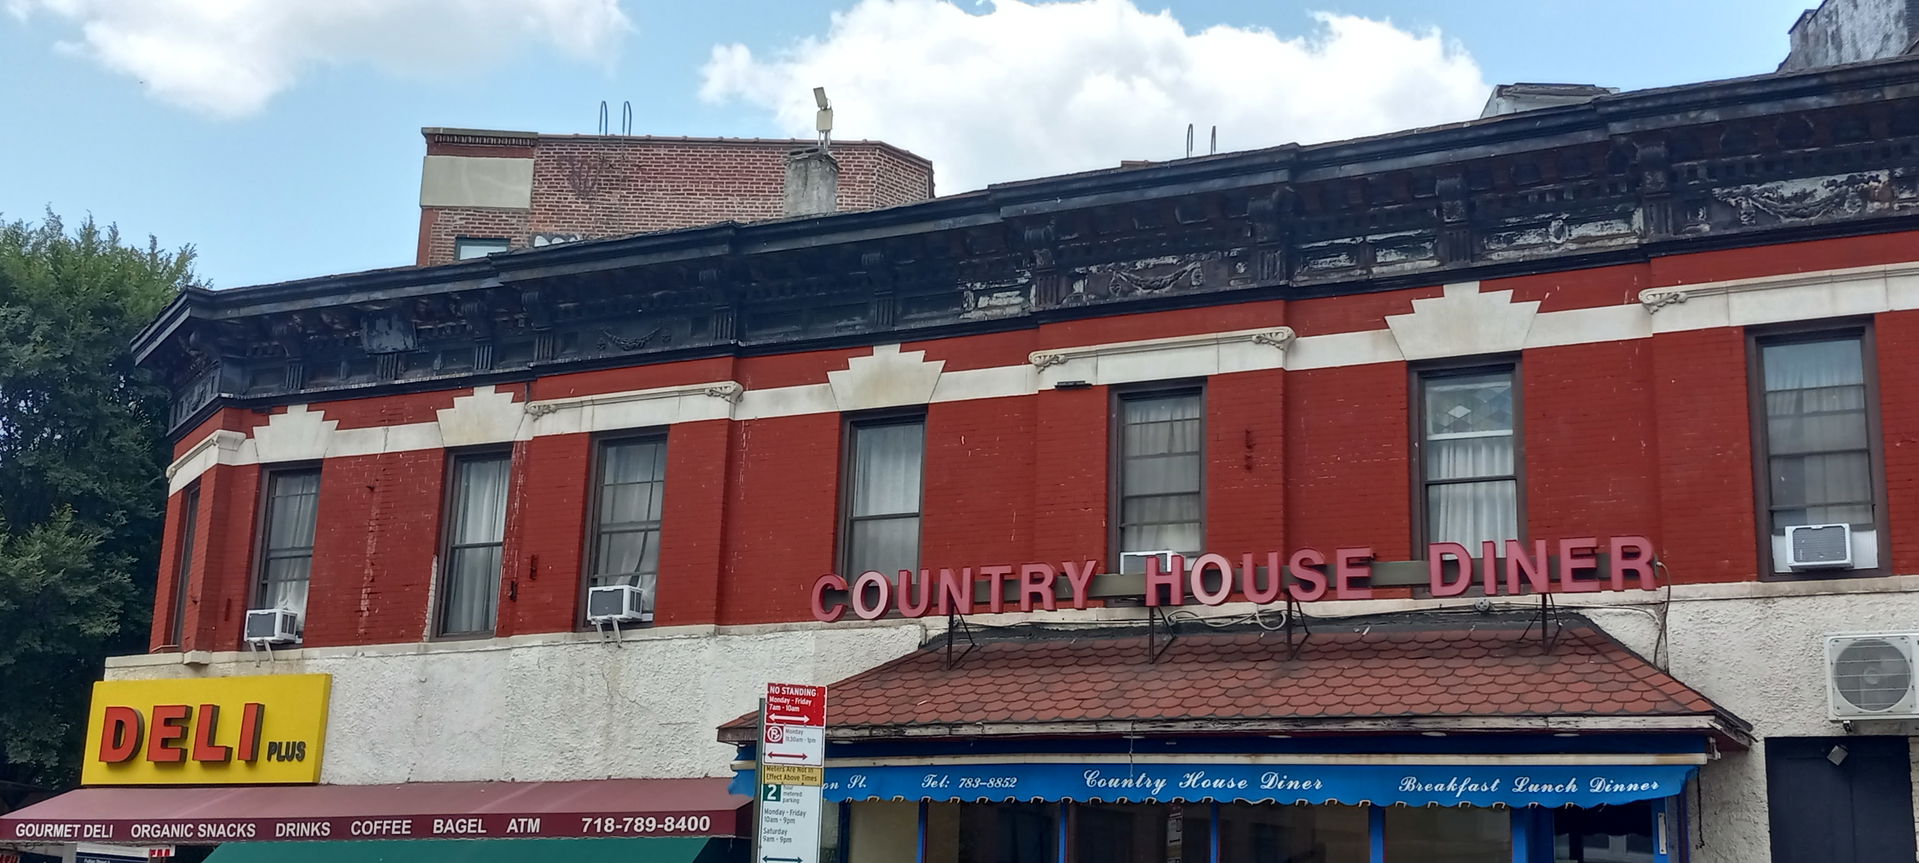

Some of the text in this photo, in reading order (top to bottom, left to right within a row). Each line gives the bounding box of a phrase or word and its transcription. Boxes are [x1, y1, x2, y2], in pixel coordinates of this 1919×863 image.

[811, 535, 1657, 622] COUNTRY HOUSE DINER
[769, 686, 817, 697] NO STANDING
[769, 696, 790, 704] Monday
[795, 697, 812, 707] Friday
[786, 704, 800, 712] 10am
[99, 703, 306, 763] DELI PLUS
[785, 728, 804, 736] Monday
[766, 772, 817, 782] Effect Above Times
[822, 774, 867, 790] on St.
[921, 773, 1018, 789] Tel: 783-8852
[1083, 769, 1323, 795] Country House Diner
[767, 784, 777, 800] 2
[1398, 776, 1660, 797] Breakfast Lunch Dinner
[764, 808, 785, 817] Monday
[789, 808, 806, 818] Friday
[350, 820, 412, 835] COFFEE
[432, 818, 487, 834] BAGEL
[506, 818, 541, 833] ATM
[581, 815, 711, 833] 718-789-8400
[783, 817, 795, 825] 9pm
[15, 823, 113, 838] GOURMET DELI
[131, 822, 256, 838] ORGANIC SNACKS
[275, 822, 331, 837] DRINKS
[763, 828, 787, 836] Saturday
